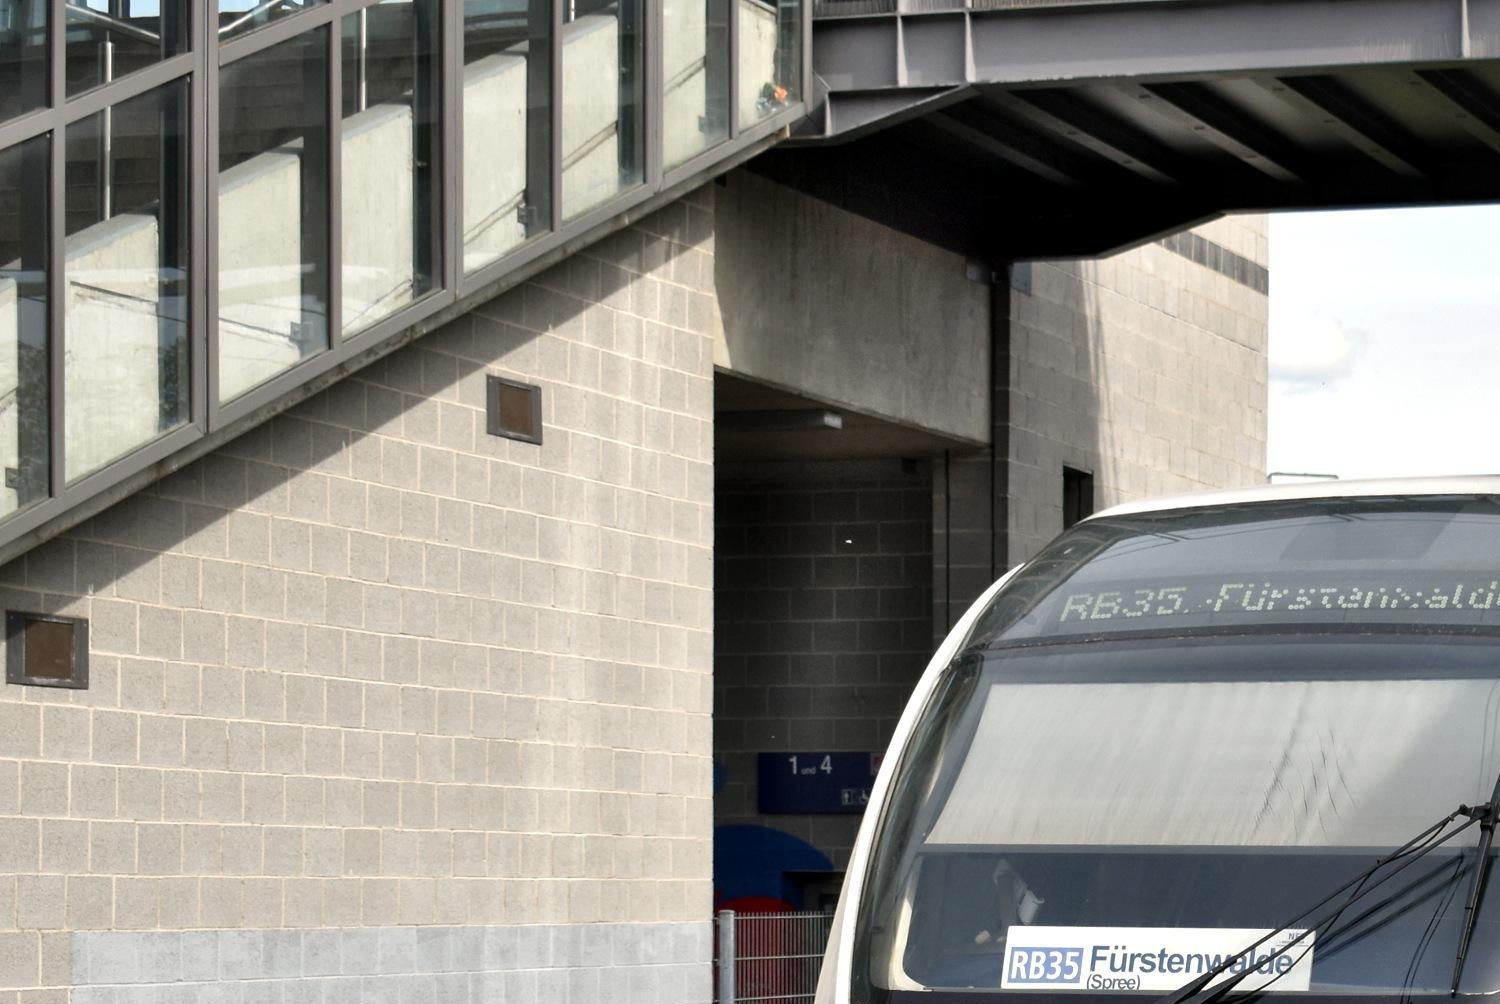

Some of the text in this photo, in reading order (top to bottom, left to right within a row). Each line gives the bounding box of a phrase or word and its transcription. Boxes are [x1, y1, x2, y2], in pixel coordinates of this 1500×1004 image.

[789, 754, 833, 775] 1 und 4
[1011, 945, 1293, 981] RB35 Fürstenwalde
[1086, 974, 1141, 991] (Spree)
